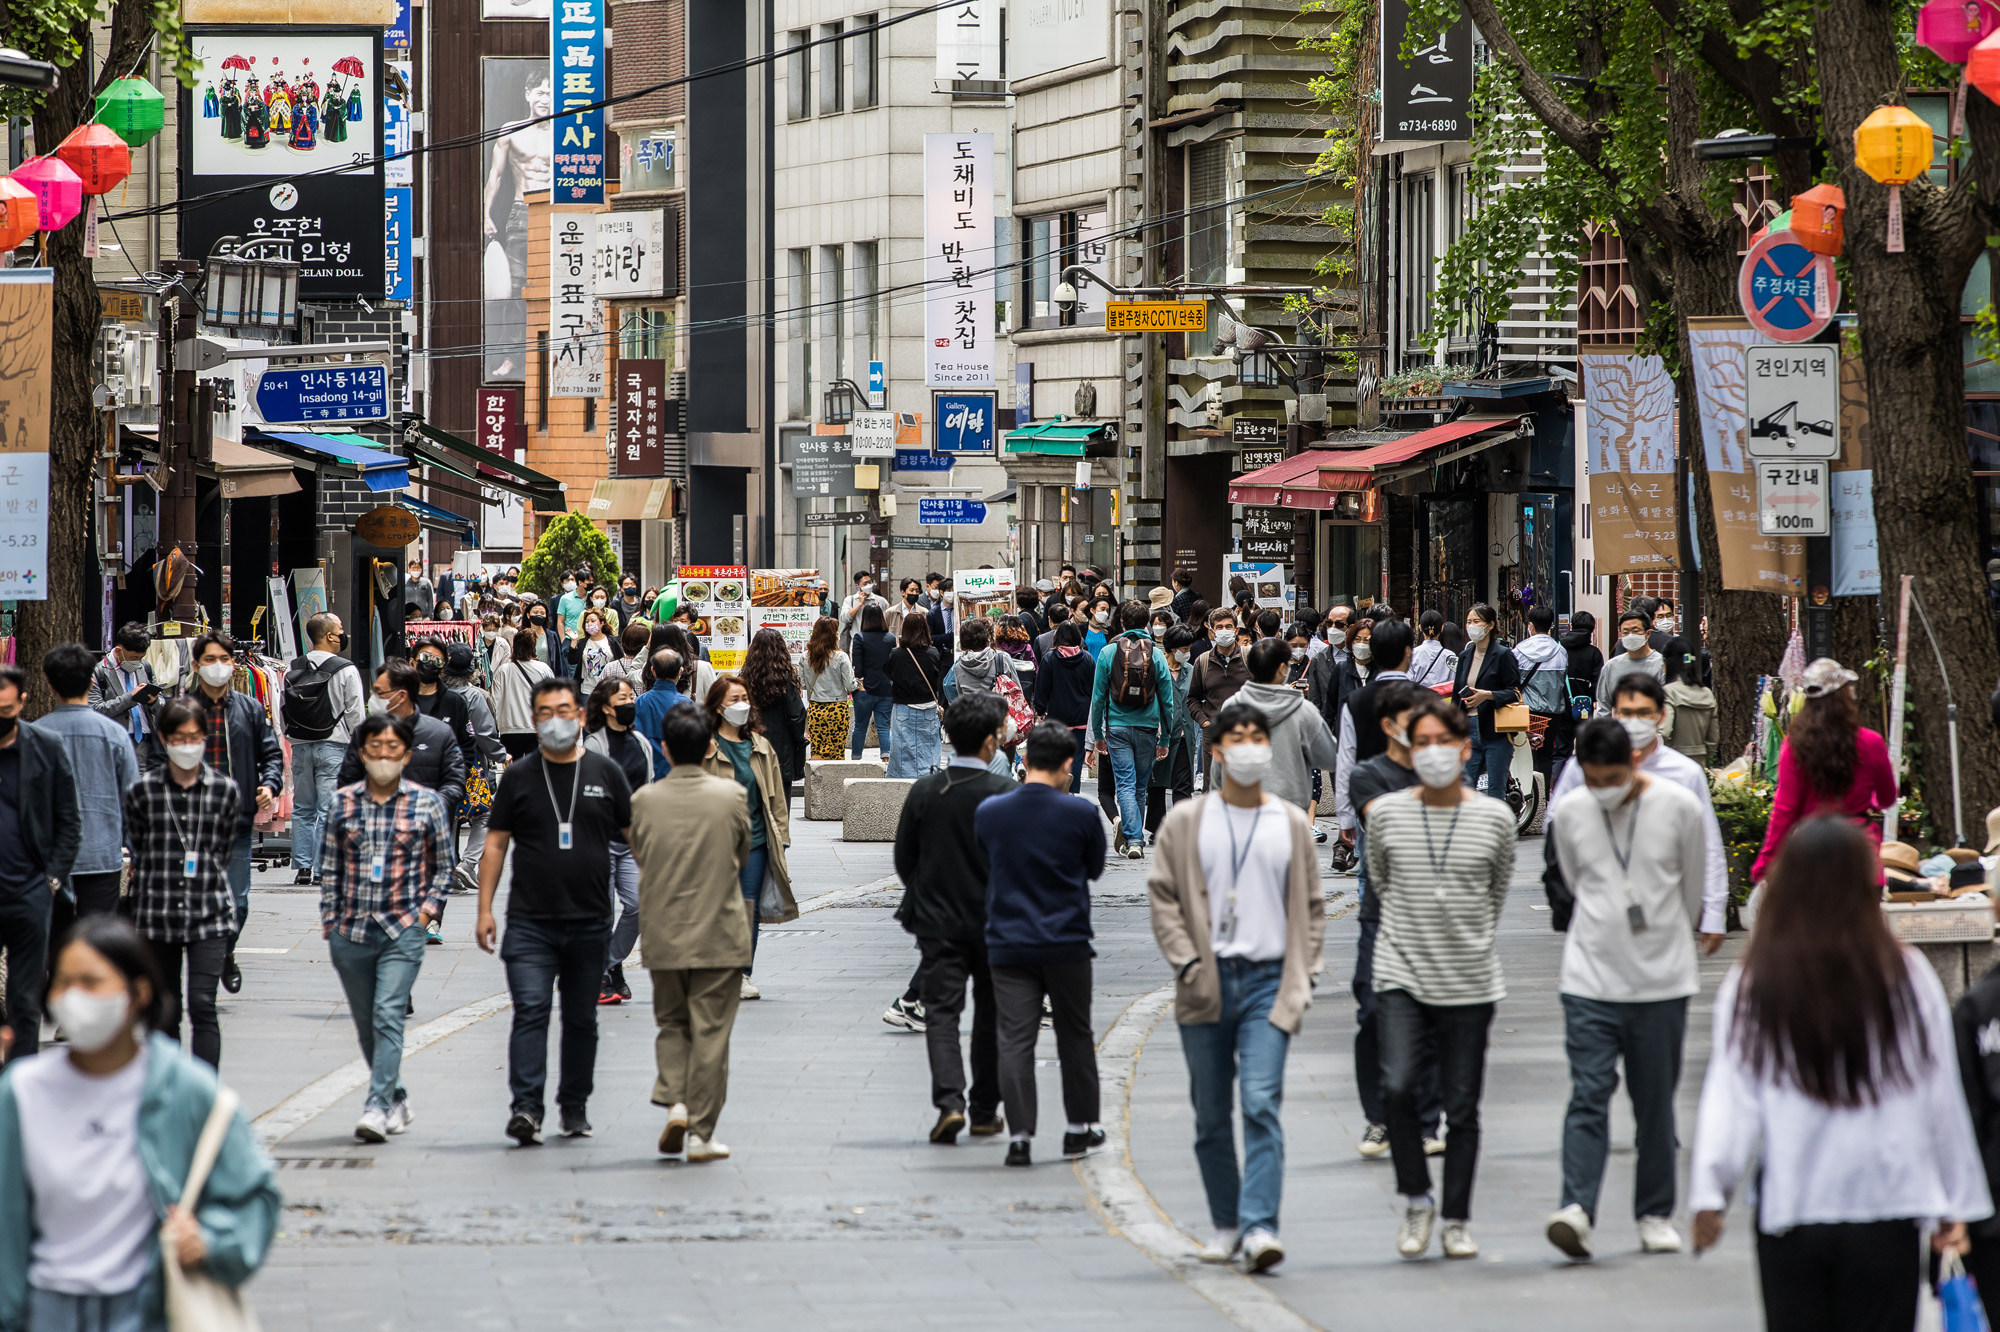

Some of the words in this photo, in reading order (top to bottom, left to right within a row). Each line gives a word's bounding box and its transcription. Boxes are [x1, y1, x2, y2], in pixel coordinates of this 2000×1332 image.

[1408, 120, 1457, 131] 734-6890
[637, 139, 674, 172] 족자
[556, 178, 602, 187] 723-0804
[953, 141, 976, 230] 도채비도
[571, 187, 586, 198] 3F
[247, 217, 321, 237] 오주현
[301, 242, 351, 263] 인형
[335, 268, 364, 277] DOLL
[1754, 276, 1815, 296] 주정차금
[559, 221, 587, 366] 운경표구사
[954, 300, 976, 349] 찻집
[935, 363, 953, 371] Tea
[957, 363, 989, 371] House
[1755, 358, 1827, 377] 견인지역
[588, 373, 601, 383] 2F
[935, 373, 963, 382] Since
[966, 373, 990, 382] 2011
[299, 392, 349, 404] Insadong
[352, 390, 382, 402] 14-gil
[946, 402, 967, 411] Gallery
[626, 373, 642, 461] 국제자수원
[485, 395, 506, 457] 한양화
[855, 418, 863, 429] 차
[864, 418, 877, 429] 없는
[879, 418, 892, 430] 거리
[799, 442, 829, 453] 인사동
[982, 439, 990, 449] 1F
[1767, 468, 1819, 485] 구간내
[1775, 515, 1814, 528] 100m
[965, 575, 995, 588] 나무새
[762, 613, 788, 621] 47번가
